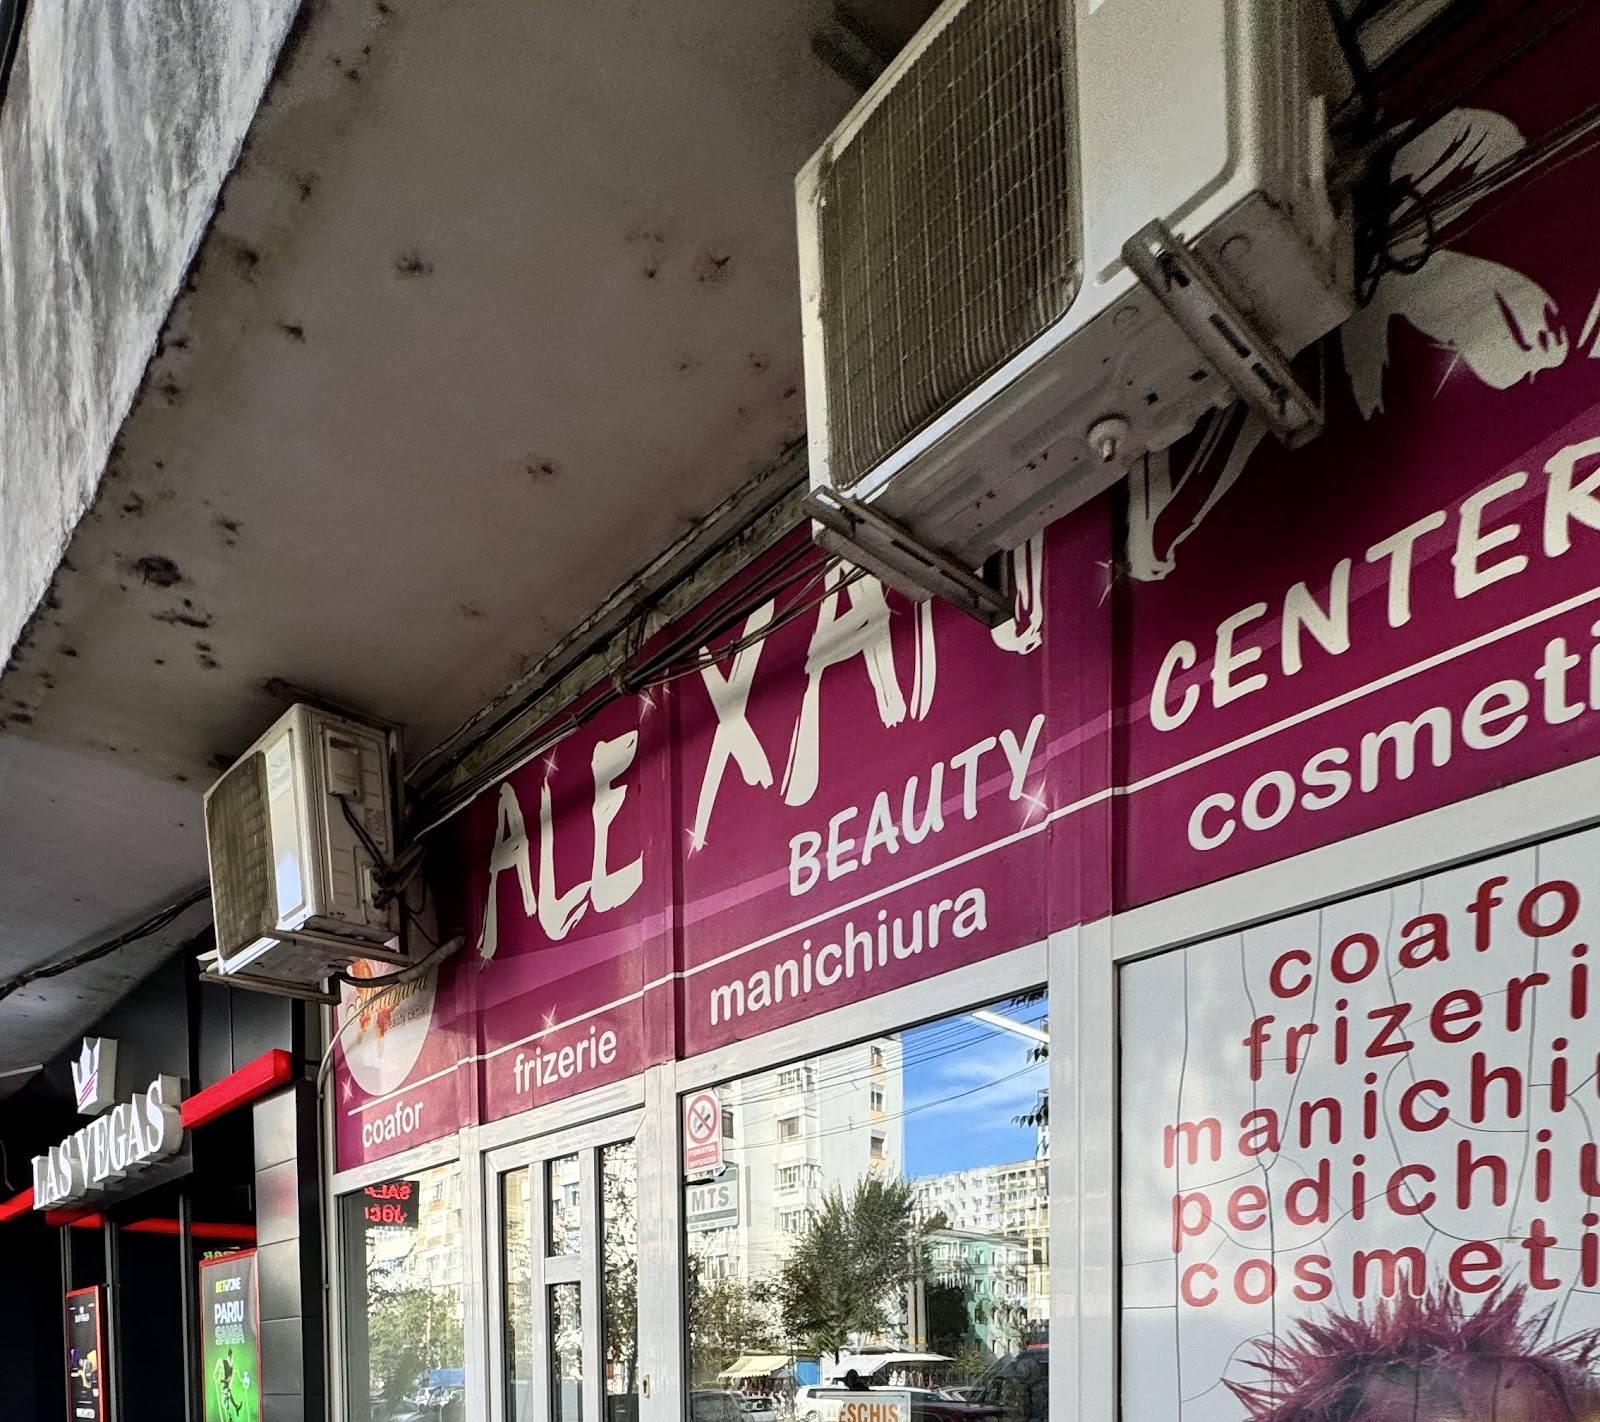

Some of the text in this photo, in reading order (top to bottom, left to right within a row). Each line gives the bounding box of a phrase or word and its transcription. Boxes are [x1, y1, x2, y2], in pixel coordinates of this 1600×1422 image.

[788, 436, 1600, 897] BEAUTY CENTER
[1269, 876, 1582, 999] coafo
[362, 1100, 424, 1148] coafor
[513, 1025, 617, 1096] frizerie
[710, 888, 987, 1026] manichiura
[1243, 943, 1589, 1082] frizeri
[31, 1073, 164, 1211] LAS VEGAS
[1163, 1037, 1600, 1169] manichi
[214, 1300, 244, 1324] PARIU
[1180, 1212, 1599, 1308] cosmeti
